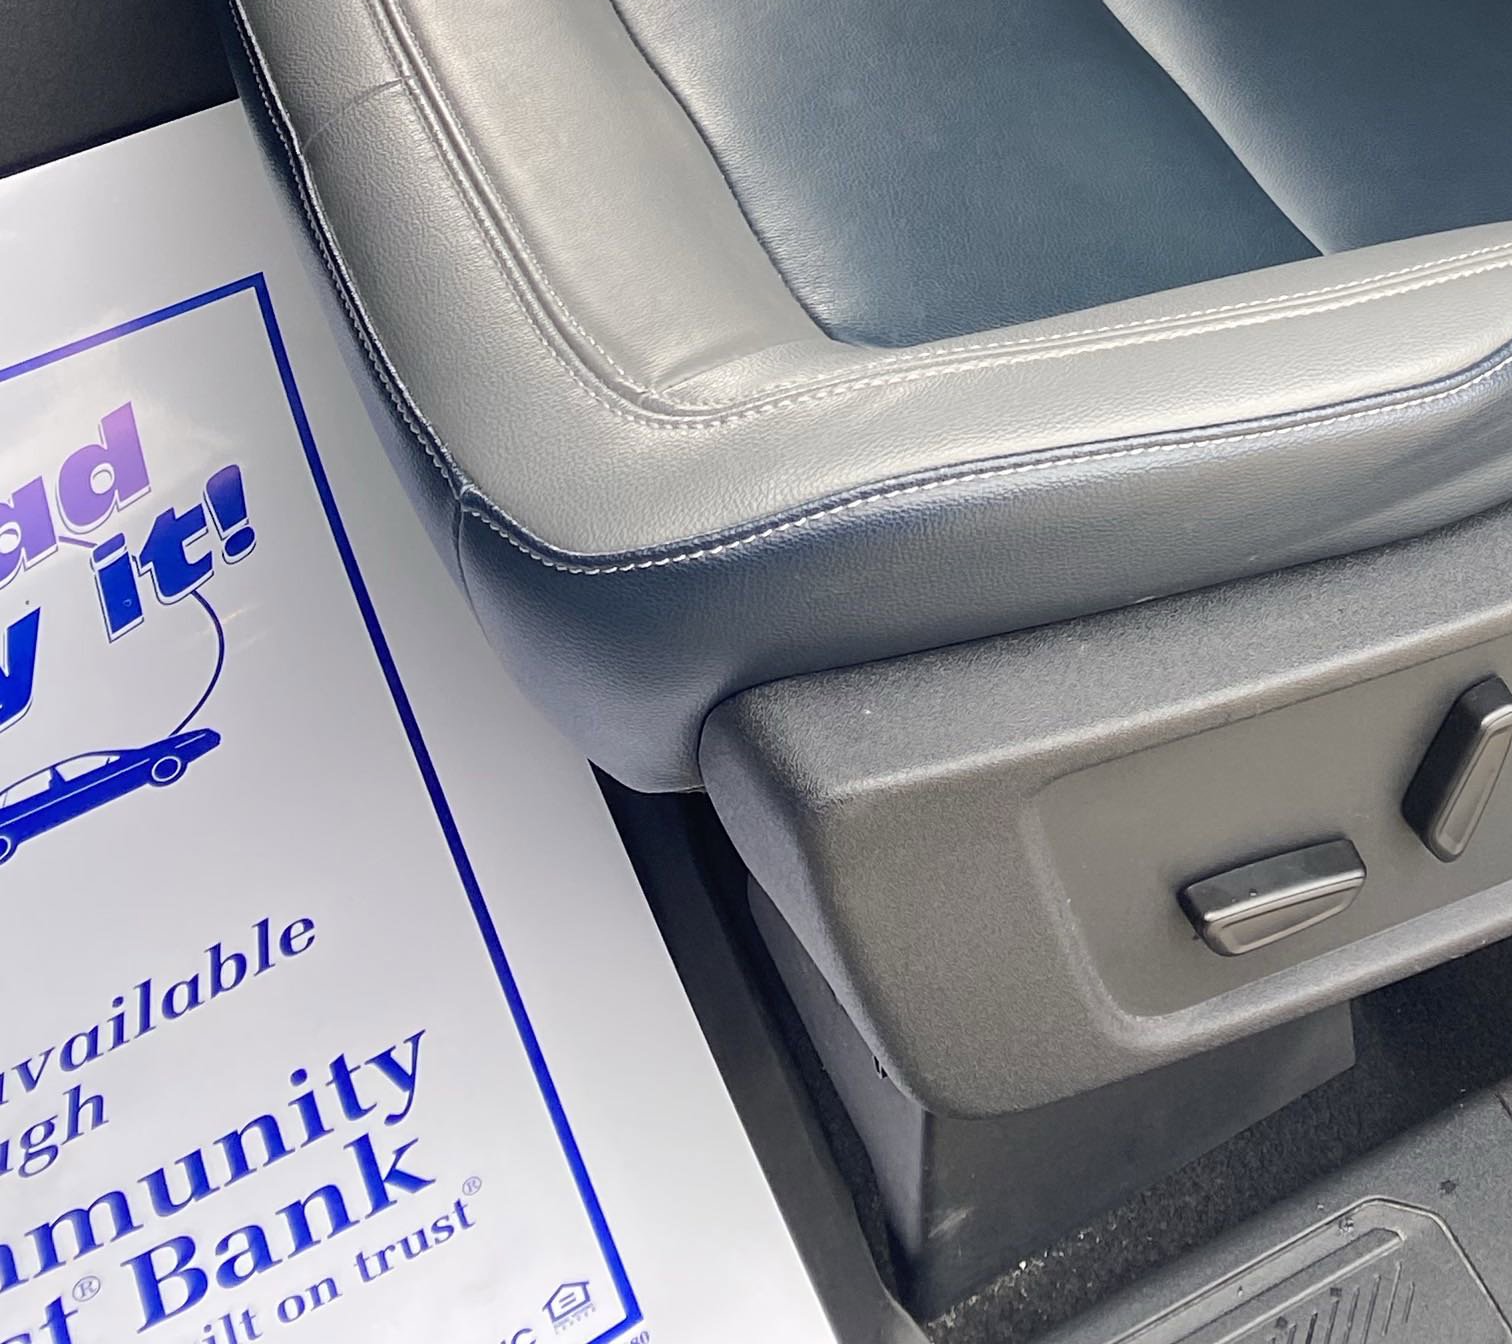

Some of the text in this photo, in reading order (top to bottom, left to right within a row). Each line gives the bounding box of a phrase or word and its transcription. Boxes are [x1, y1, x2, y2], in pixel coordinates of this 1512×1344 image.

[90, 463, 256, 644] it!
[0, 917, 316, 1106] vailable
[0, 1028, 426, 1293] munity
[119, 1131, 437, 1334] Bank
[276, 1274, 343, 1323] on
